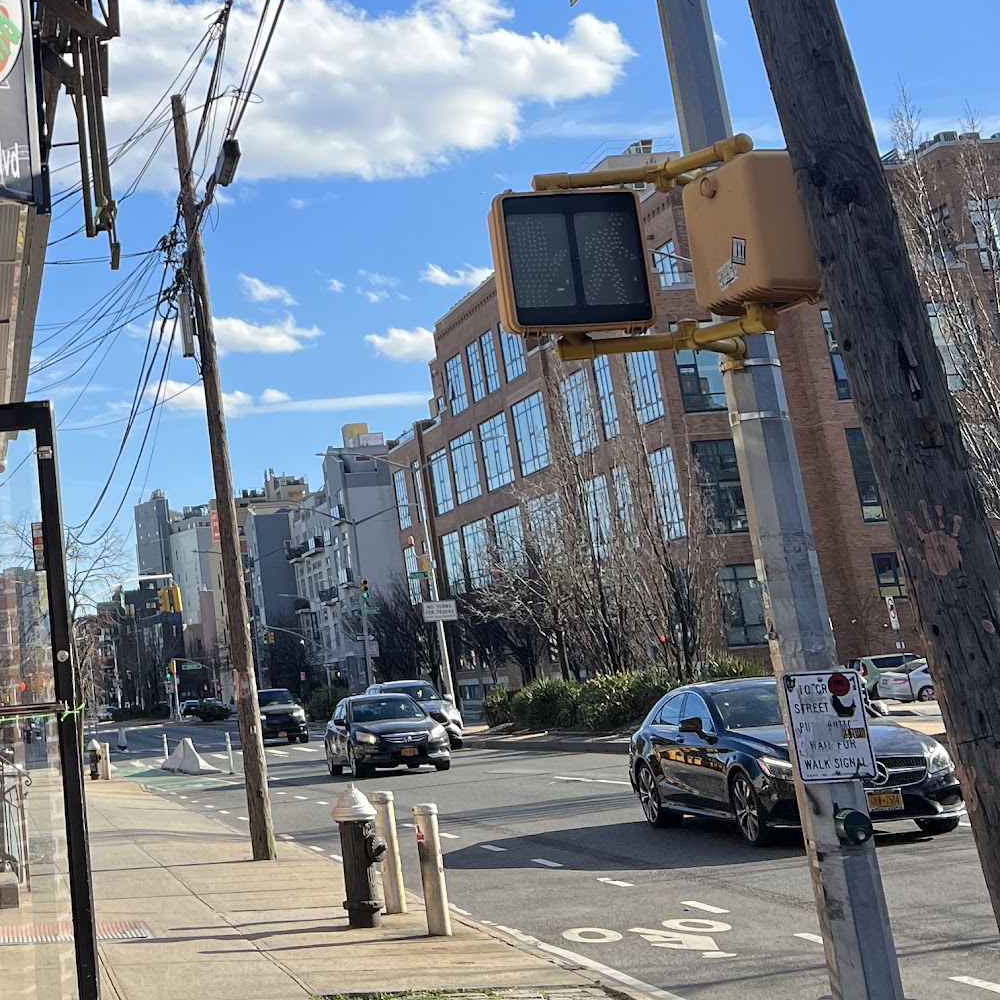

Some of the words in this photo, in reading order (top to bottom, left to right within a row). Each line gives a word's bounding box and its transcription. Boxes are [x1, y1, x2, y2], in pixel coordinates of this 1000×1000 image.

[799, 684, 811, 695] TO
[795, 702, 829, 714] STREET
[804, 759, 831, 770] WALK
